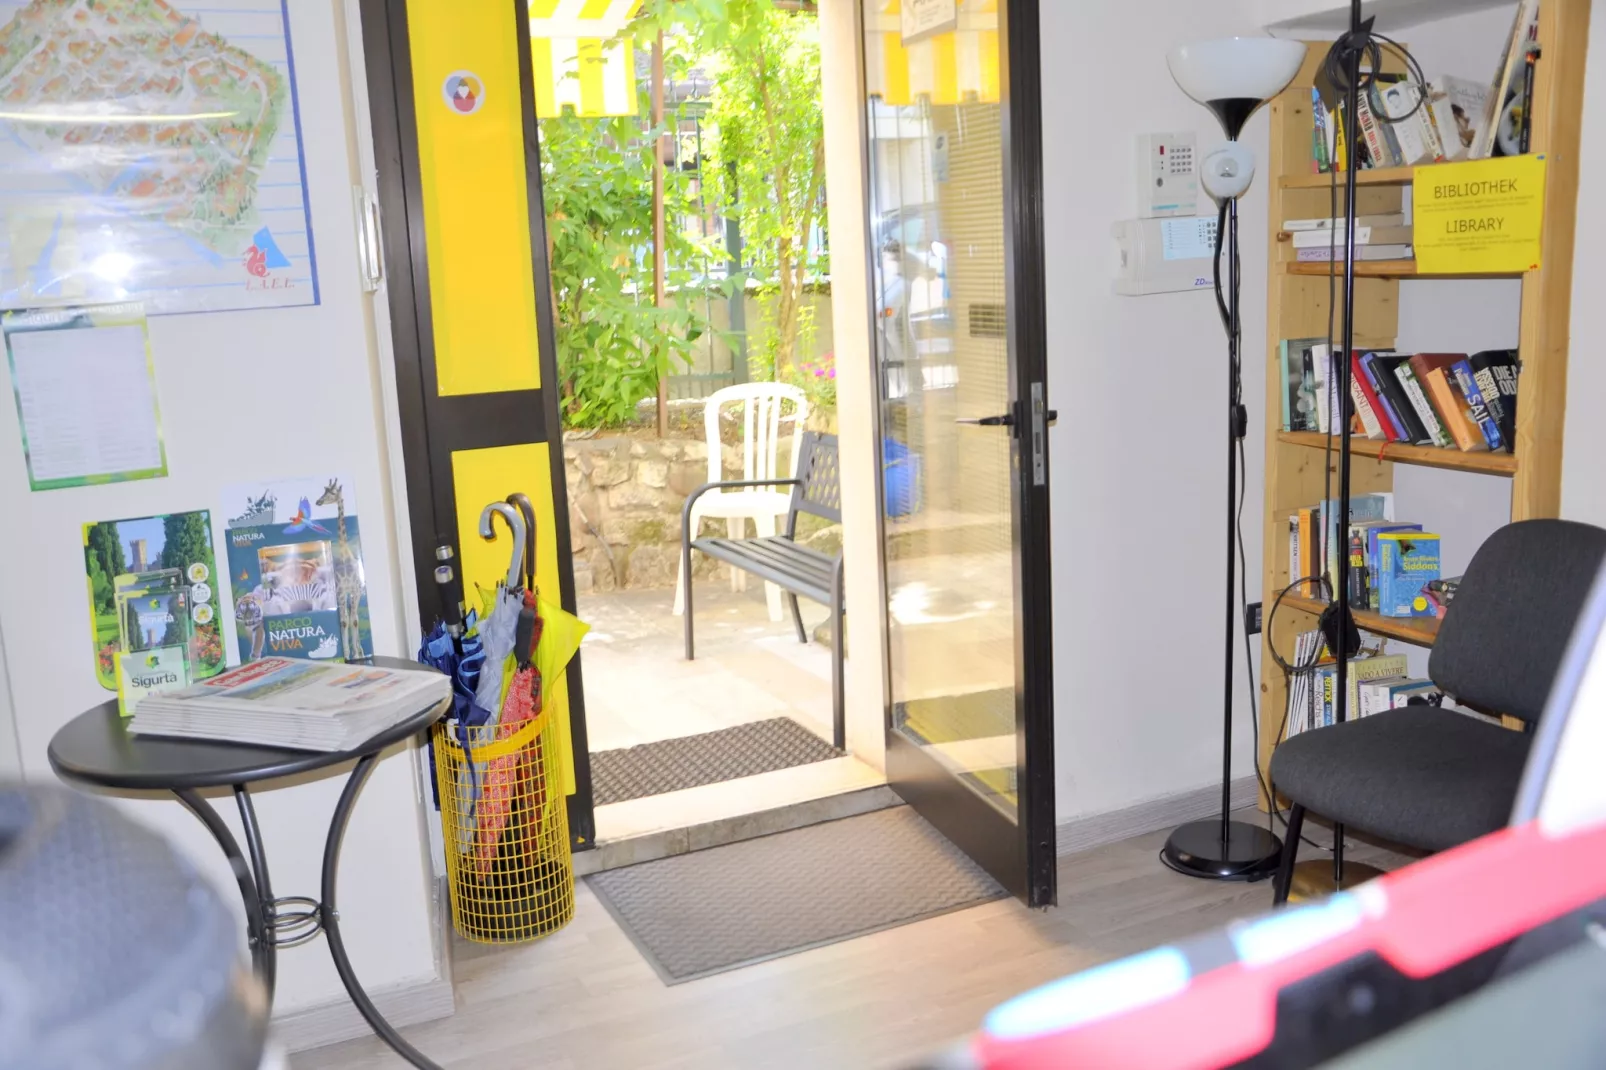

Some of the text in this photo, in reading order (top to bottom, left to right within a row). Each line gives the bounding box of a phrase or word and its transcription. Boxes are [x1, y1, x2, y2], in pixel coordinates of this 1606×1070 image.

[1434, 178, 1518, 199] BIBLIOTHEK
[1446, 217, 1504, 234] LIBRARY
[1468, 394, 1490, 430] SAIL
[232, 532, 266, 542] NATURA
[268, 616, 312, 631] PARCO
[269, 626, 326, 642] NATURA
[271, 639, 303, 651] VIVA
[132, 673, 178, 688] Sigurtà
